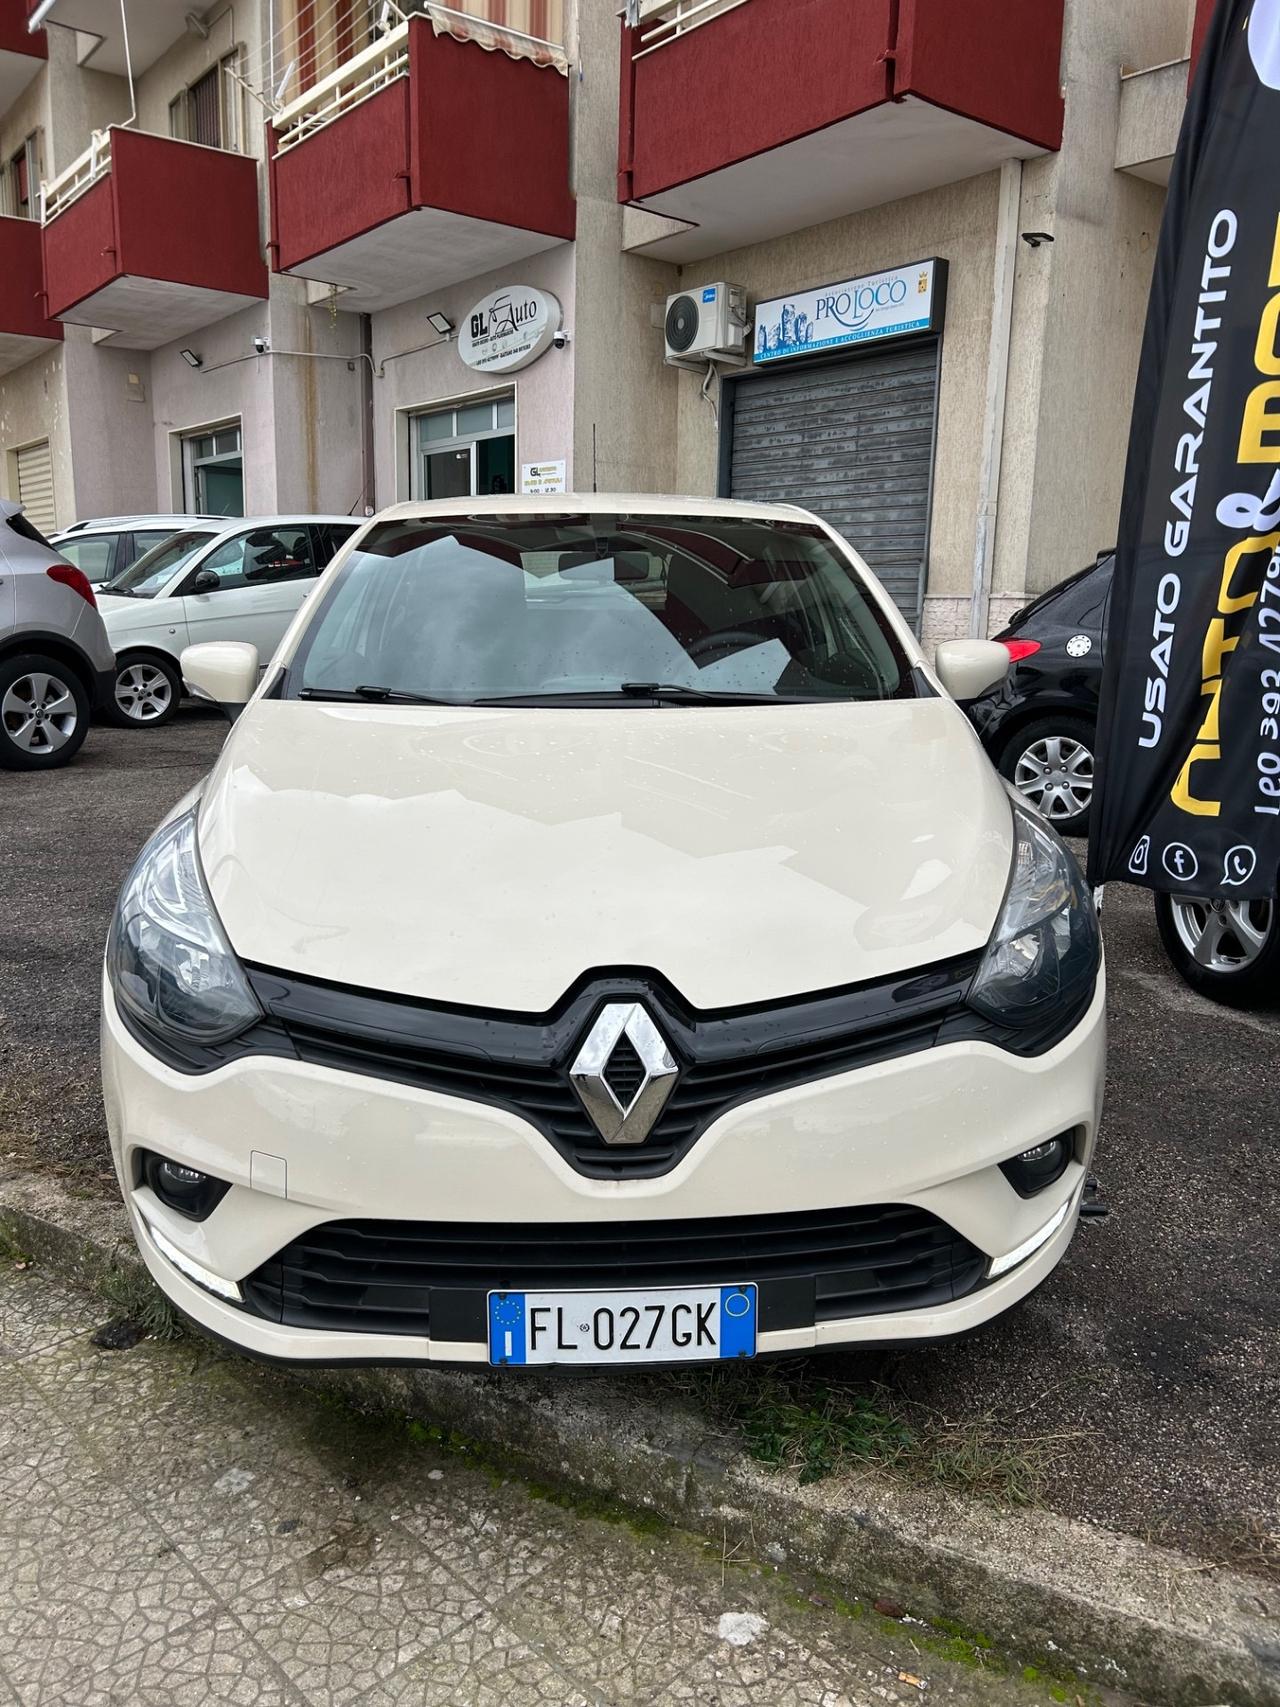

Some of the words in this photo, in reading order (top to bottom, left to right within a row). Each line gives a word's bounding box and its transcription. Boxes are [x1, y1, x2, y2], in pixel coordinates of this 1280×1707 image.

[816, 292, 851, 321] PRO
[853, 279, 907, 319] LOCO
[471, 311, 488, 338] GL
[1138, 572, 1181, 748] USATO
[1164, 209, 1237, 557] GARANTITO
[530, 1306, 578, 1350] FL
[593, 1302, 717, 1350] 027GK
